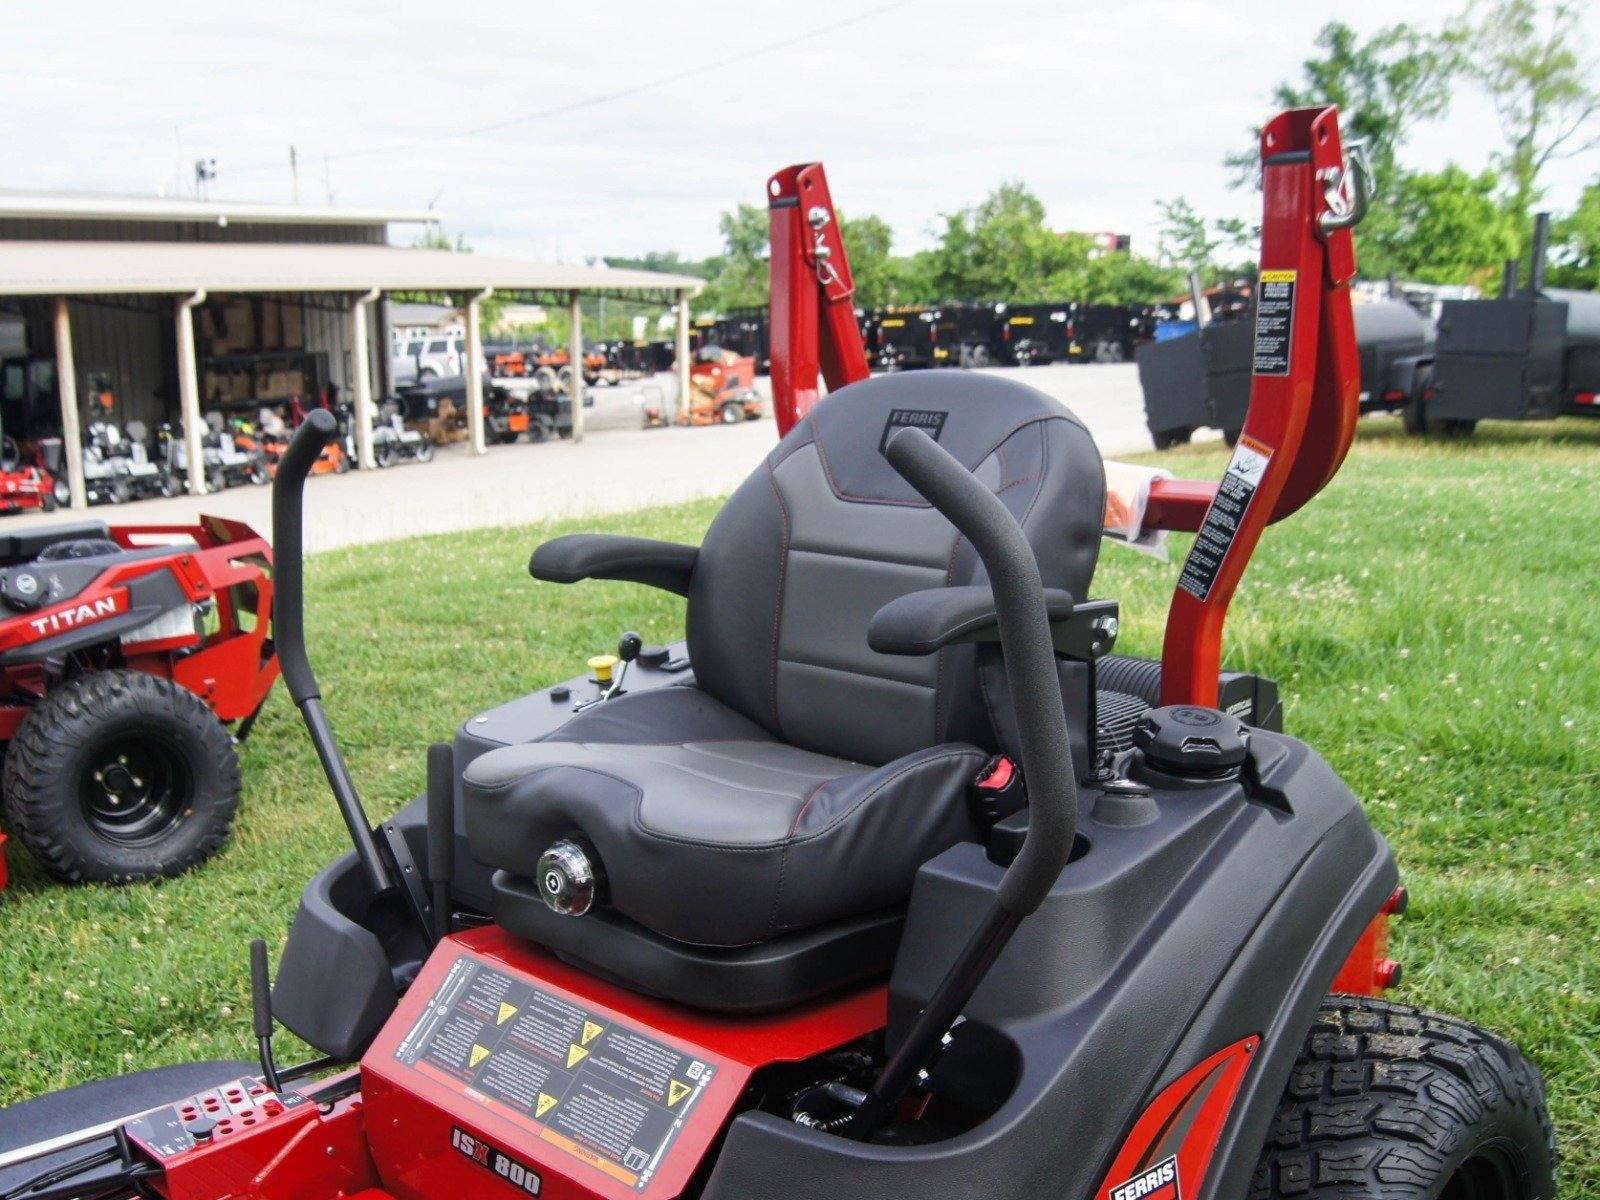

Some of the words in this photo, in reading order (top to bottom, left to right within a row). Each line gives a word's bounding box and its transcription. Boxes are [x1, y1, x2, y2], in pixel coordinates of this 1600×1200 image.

[892, 410, 942, 426] FERRIS
[30, 596, 116, 635] TITAN
[452, 1128, 489, 1166] ISX
[494, 1154, 540, 1195] 800
[1113, 1162, 1175, 1200] FERRIS
